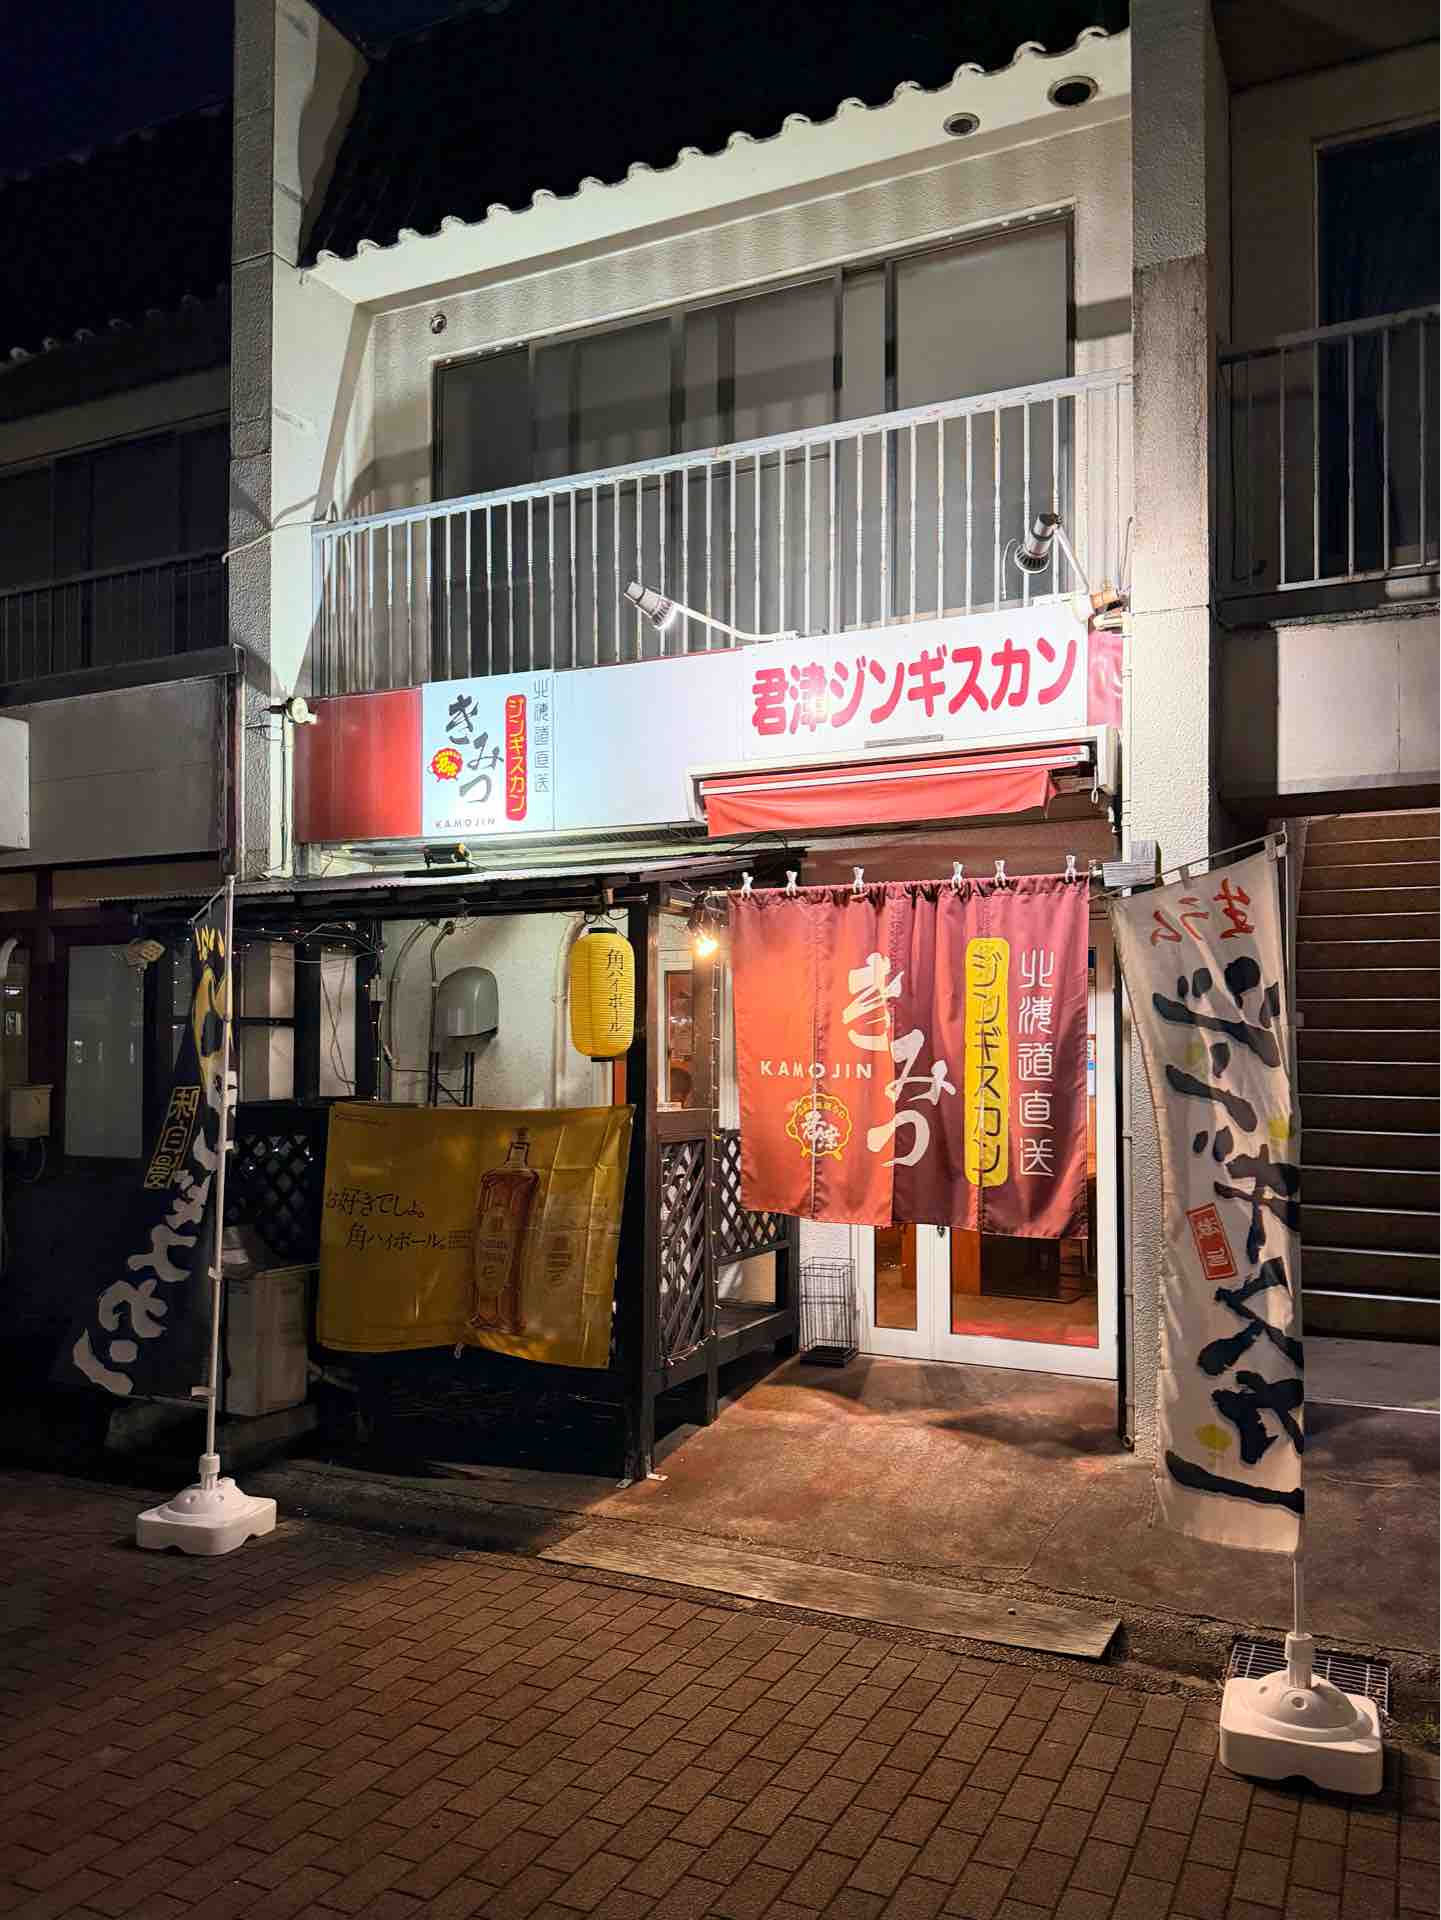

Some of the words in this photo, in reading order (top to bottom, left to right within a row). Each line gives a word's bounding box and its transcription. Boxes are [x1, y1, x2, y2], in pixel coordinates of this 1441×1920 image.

[533, 678, 550, 793] 北海道直送
[752, 638, 1077, 736] 君津ジンギスカン
[446, 694, 504, 804] きみつ
[508, 698, 526, 813] ジンギスカン
[435, 817, 496, 829] KAMOJIN
[607, 948, 625, 1033] 角ハイボール
[760, 1060, 872, 1081] KAMOJIN
[842, 952, 957, 1168] きみつ
[971, 951, 1003, 1174] ジンギスカン
[1018, 948, 1055, 1178] 北海道直送
[325, 1185, 425, 1218] お好きでしょ。
